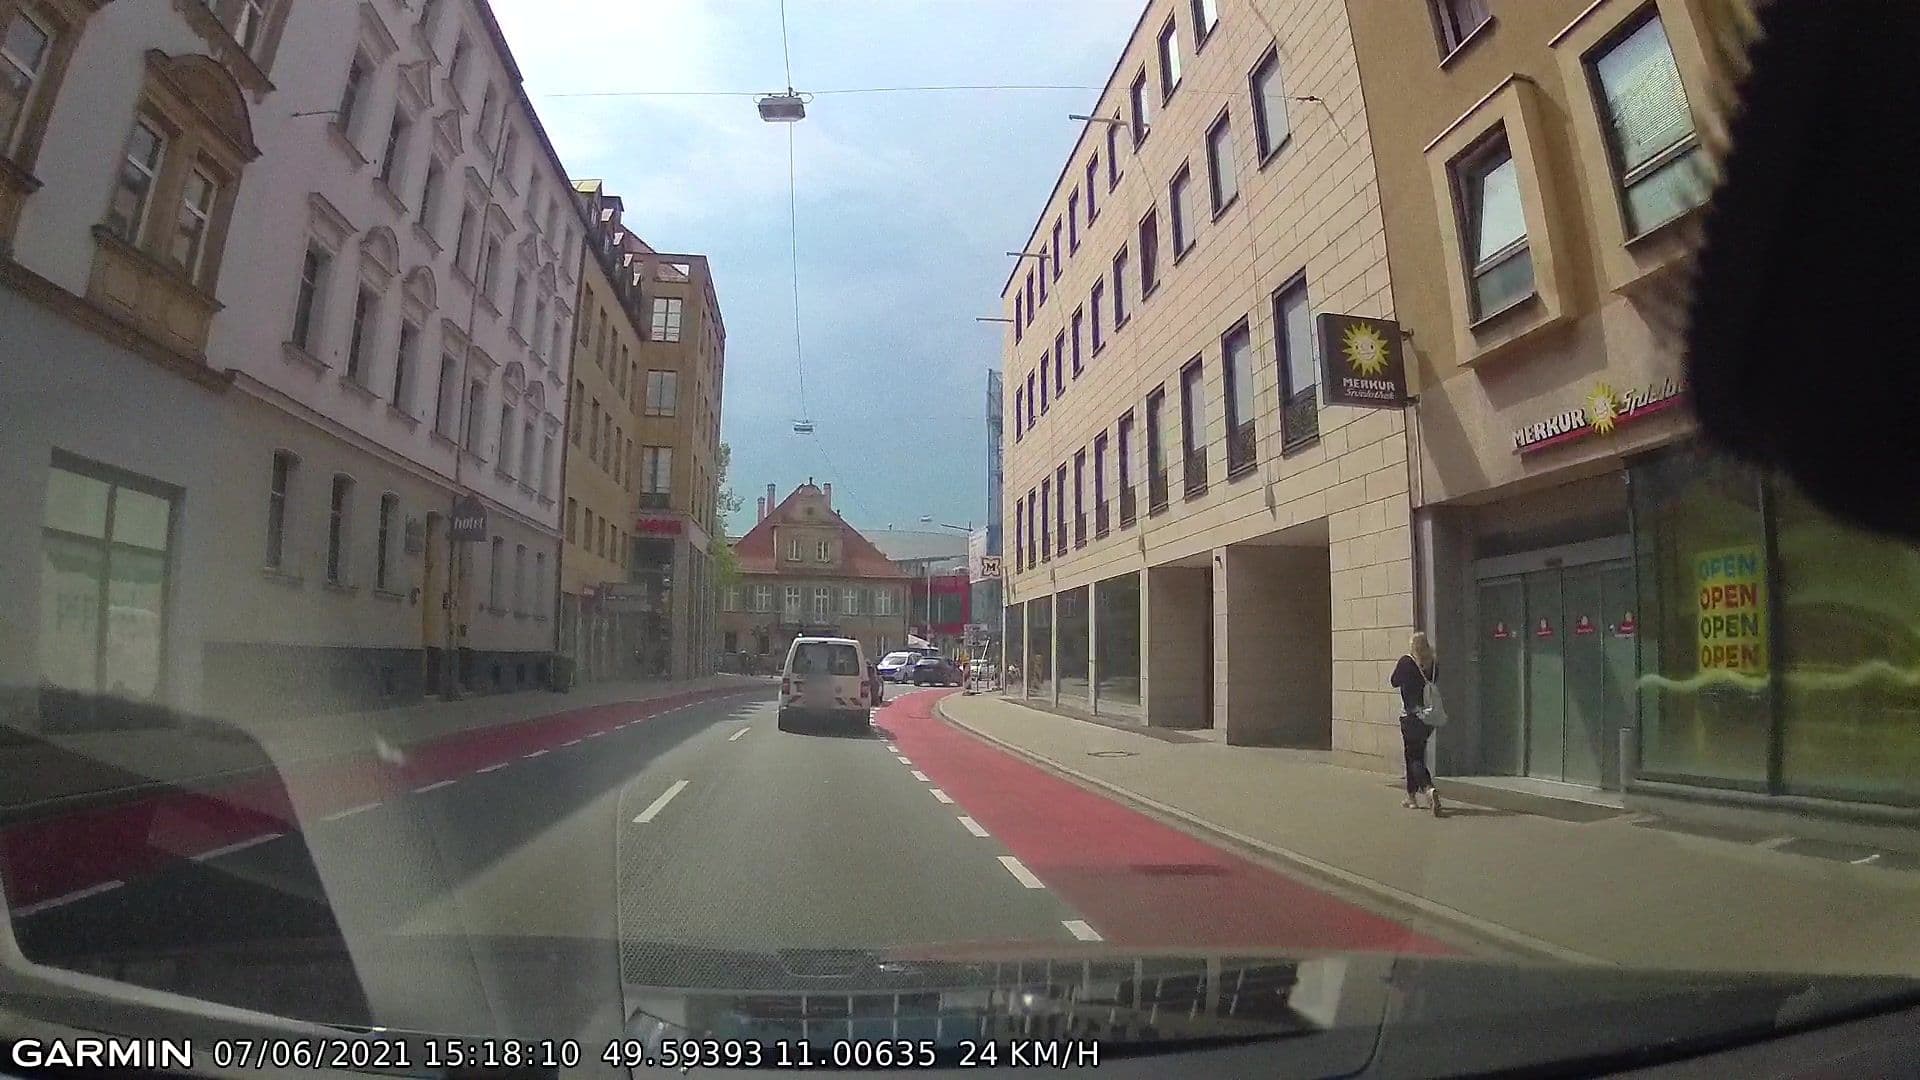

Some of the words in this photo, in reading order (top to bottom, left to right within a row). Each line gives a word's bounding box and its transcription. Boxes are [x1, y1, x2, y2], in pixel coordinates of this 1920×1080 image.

[1342, 377, 1396, 391] MERKUR
[1512, 408, 1587, 447] MERKUR
[454, 516, 484, 529] hotel
[1699, 553, 1757, 579] OPEN
[1700, 583, 1758, 610] OPEN
[1701, 613, 1759, 639] OPEN
[1701, 643, 1761, 669] OPEN
